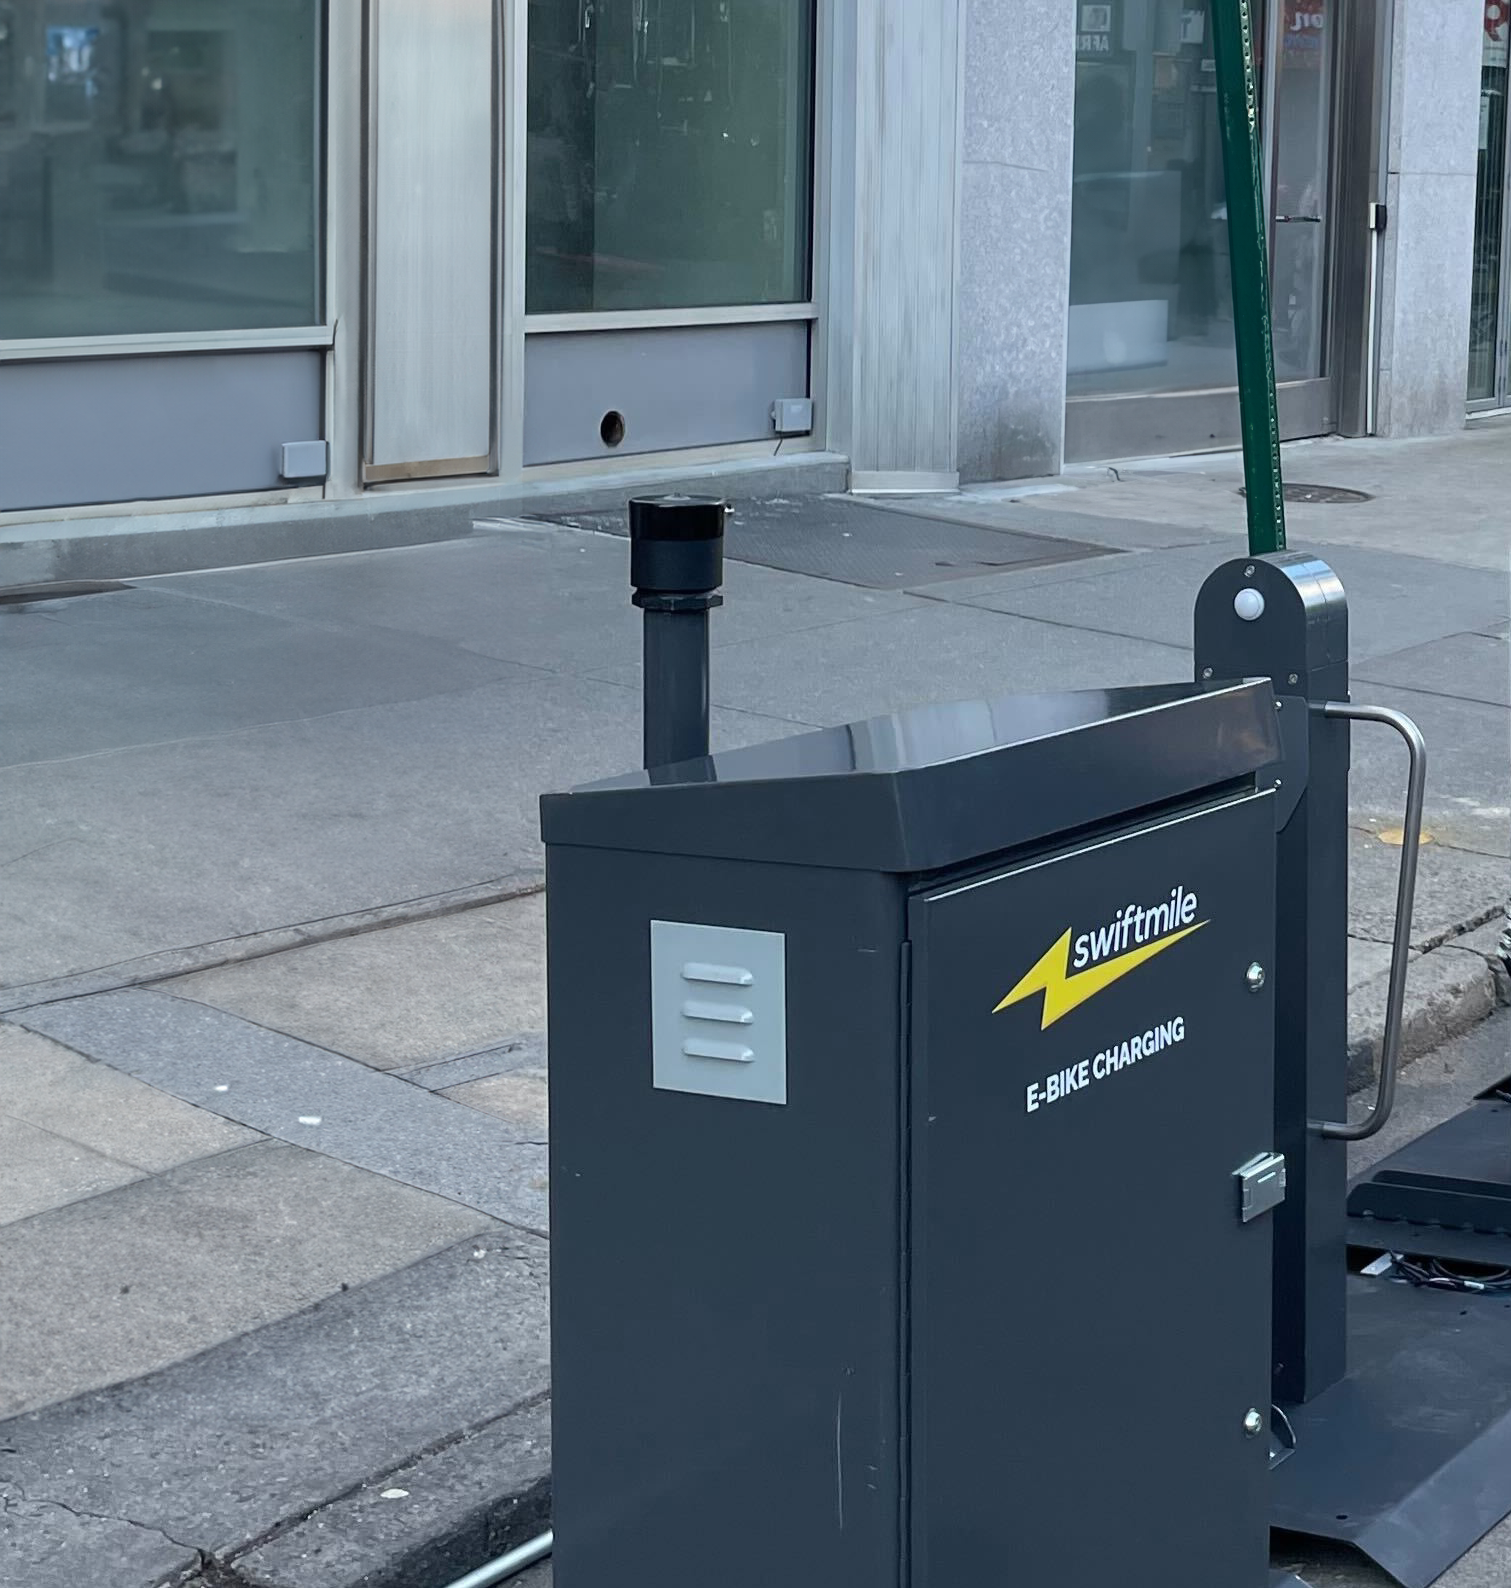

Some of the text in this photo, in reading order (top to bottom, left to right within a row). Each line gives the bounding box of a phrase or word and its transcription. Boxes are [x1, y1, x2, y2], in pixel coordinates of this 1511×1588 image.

[1073, 885, 1198, 968] swiftmile
[1026, 1016, 1185, 1113] E-BIKE CHARGING
